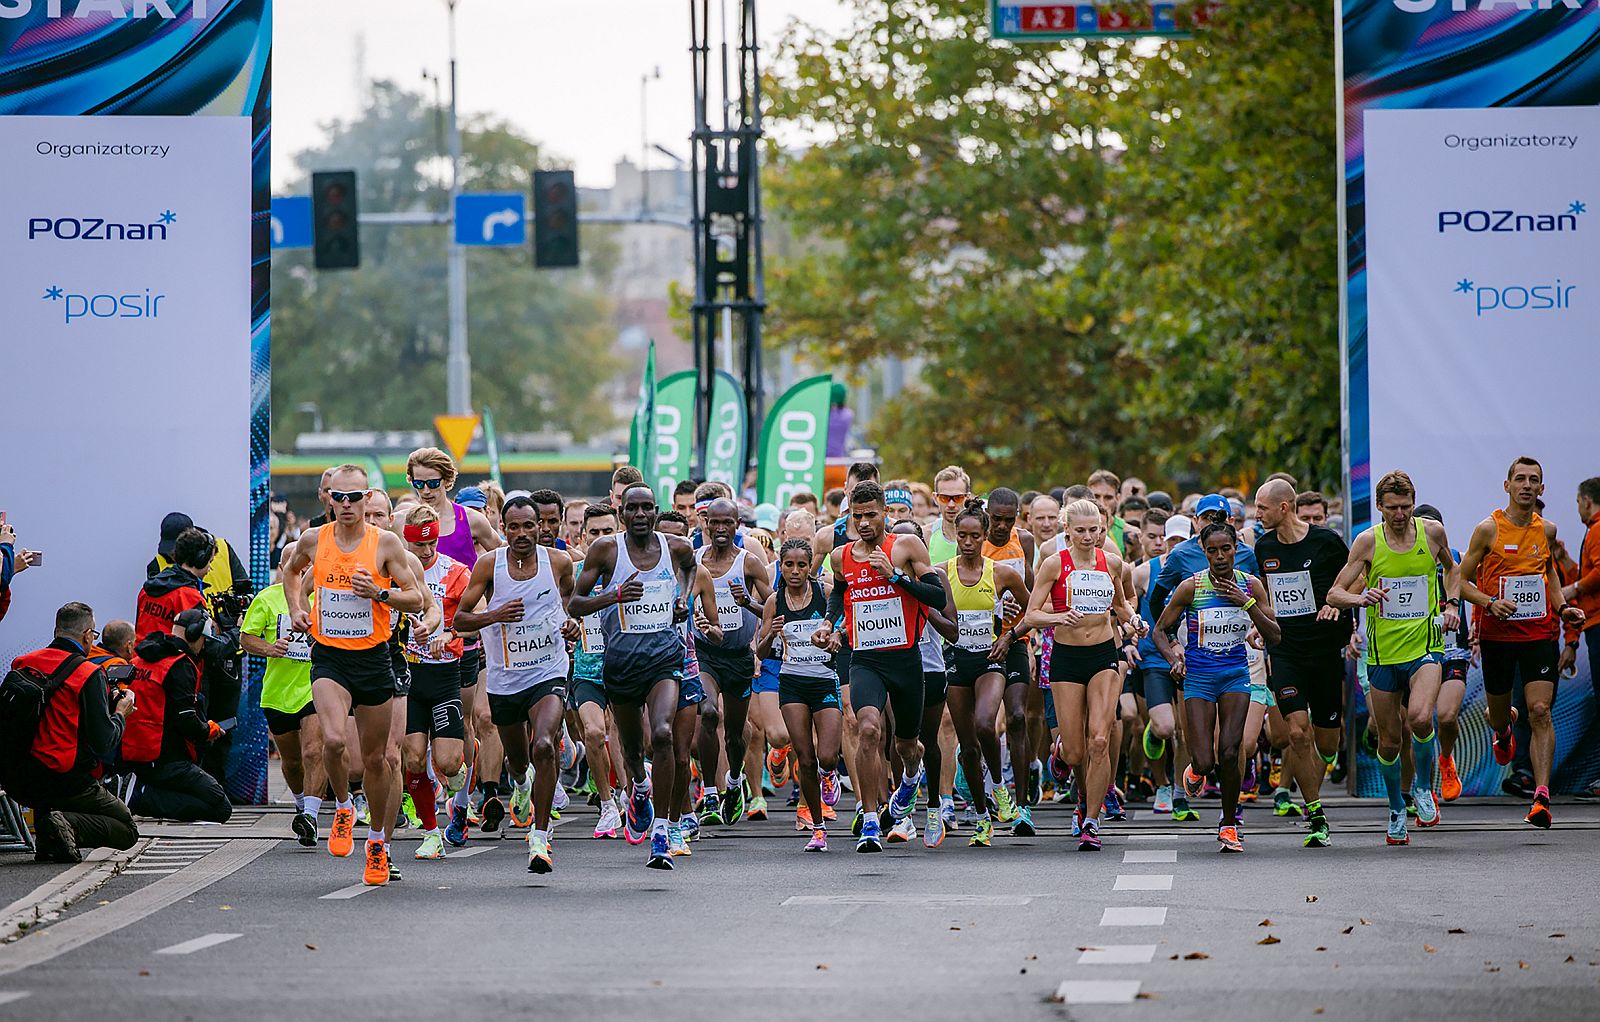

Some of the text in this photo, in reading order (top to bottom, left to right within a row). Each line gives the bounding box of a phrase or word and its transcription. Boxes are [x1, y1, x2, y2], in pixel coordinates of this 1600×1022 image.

[1444, 134, 1578, 150] Organizatorzy
[36, 141, 170, 158] Organizatorzy
[1476, 280, 1577, 316] posir
[65, 289, 166, 324] posir
[1081, 573, 1089, 581] 21
[1277, 578, 1285, 586] 21
[1392, 581, 1401, 590] 21
[1514, 580, 1523, 588] 21
[330, 593, 340, 602] 21
[1072, 588, 1113, 598] LINDHOLM
[1275, 588, 1307, 605] KĘSY
[1511, 592, 1540, 603] 3880
[1398, 593, 1413, 604] 57
[144, 602, 175, 621] MEDIA
[624, 602, 670, 616] KIPSAAT
[863, 604, 872, 614] 21
[322, 609, 370, 620] GŁOGOWSKI
[1214, 610, 1224, 619] 21
[629, 622, 657, 631] POZNAŃ
[657, 622, 668, 630] 2022
[793, 624, 802, 633] 21
[857, 616, 902, 631] NOUINI
[1205, 622, 1248, 635] HURISA
[325, 628, 351, 636] POZNAŃ
[516, 625, 526, 635] 21
[959, 628, 990, 636] CHASA
[286, 629, 308, 643] 32
[508, 634, 553, 653] CHALA
[861, 638, 886, 647] POZNAŃ
[1207, 639, 1231, 648] POZNAŃ
[513, 654, 552, 668] POZNAŃ 2022
